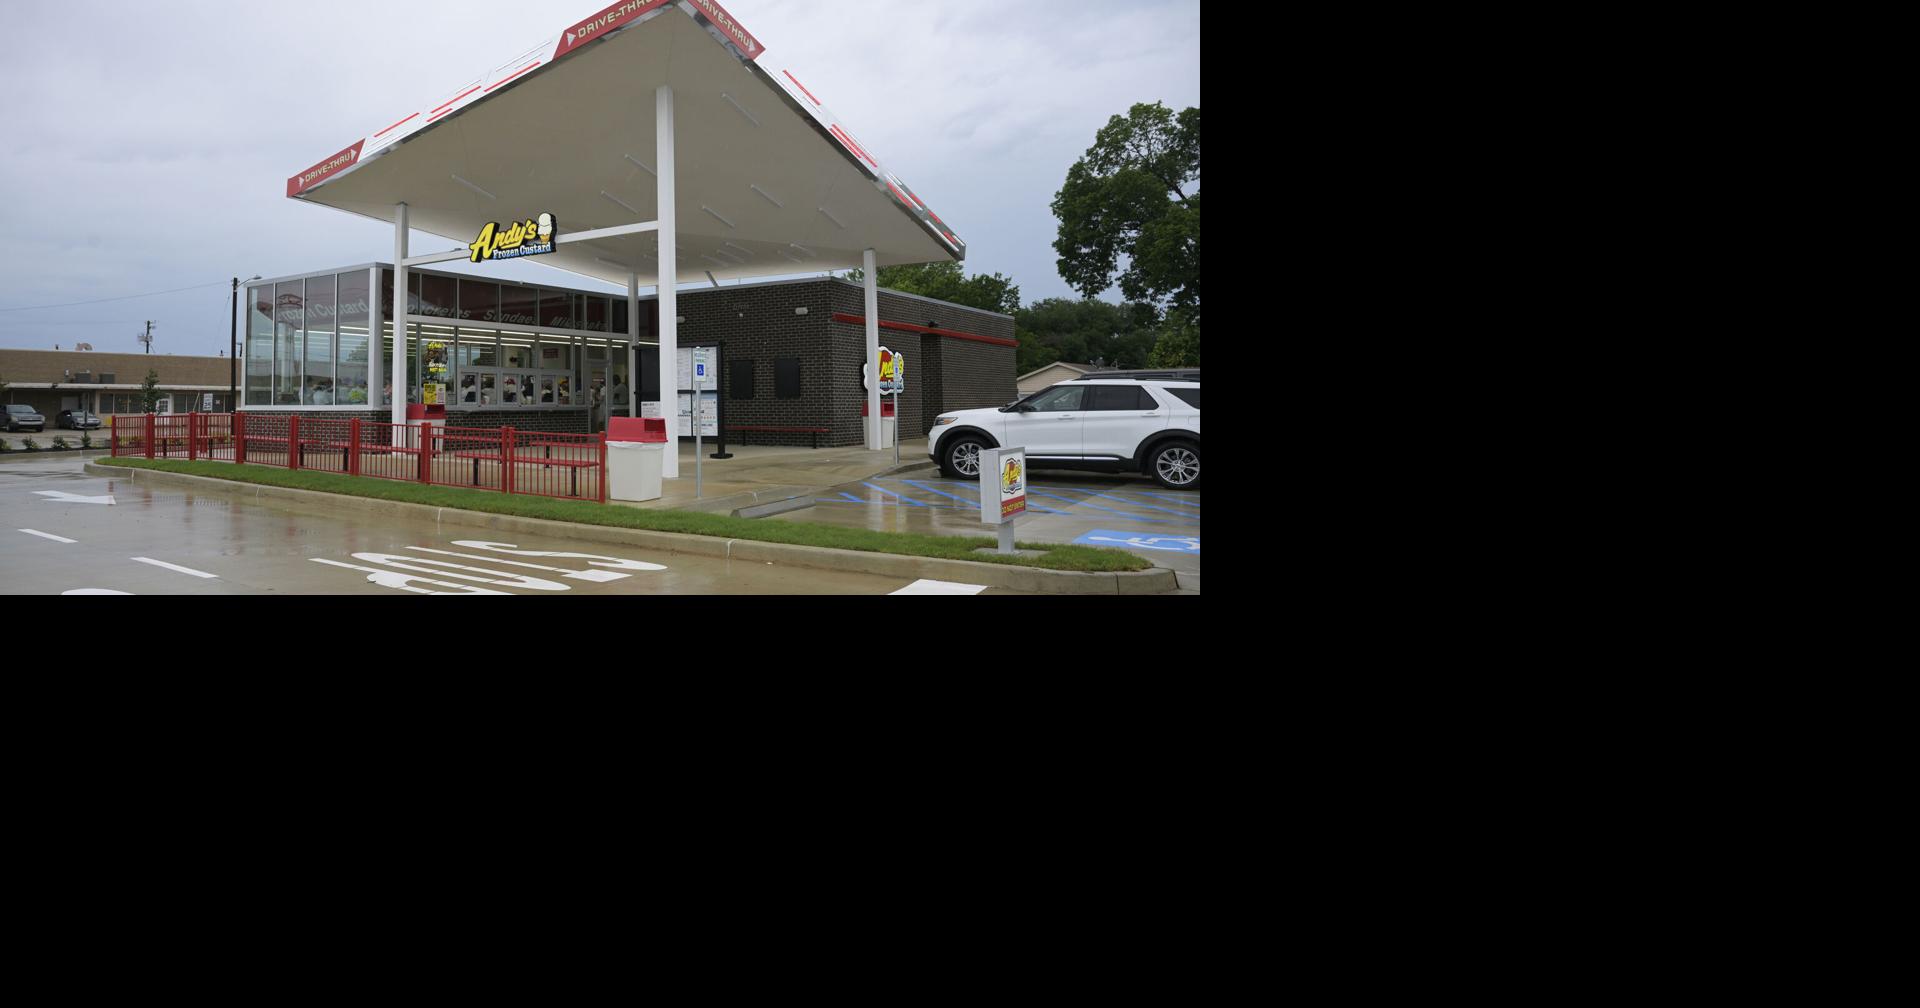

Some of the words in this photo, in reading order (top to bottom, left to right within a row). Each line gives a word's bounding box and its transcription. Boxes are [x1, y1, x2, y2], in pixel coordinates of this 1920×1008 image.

[305, 152, 350, 182] DRIVE-THRU
[470, 219, 537, 262] Andy's
[493, 248, 519, 259] Frozen
[520, 242, 551, 255] Custard
